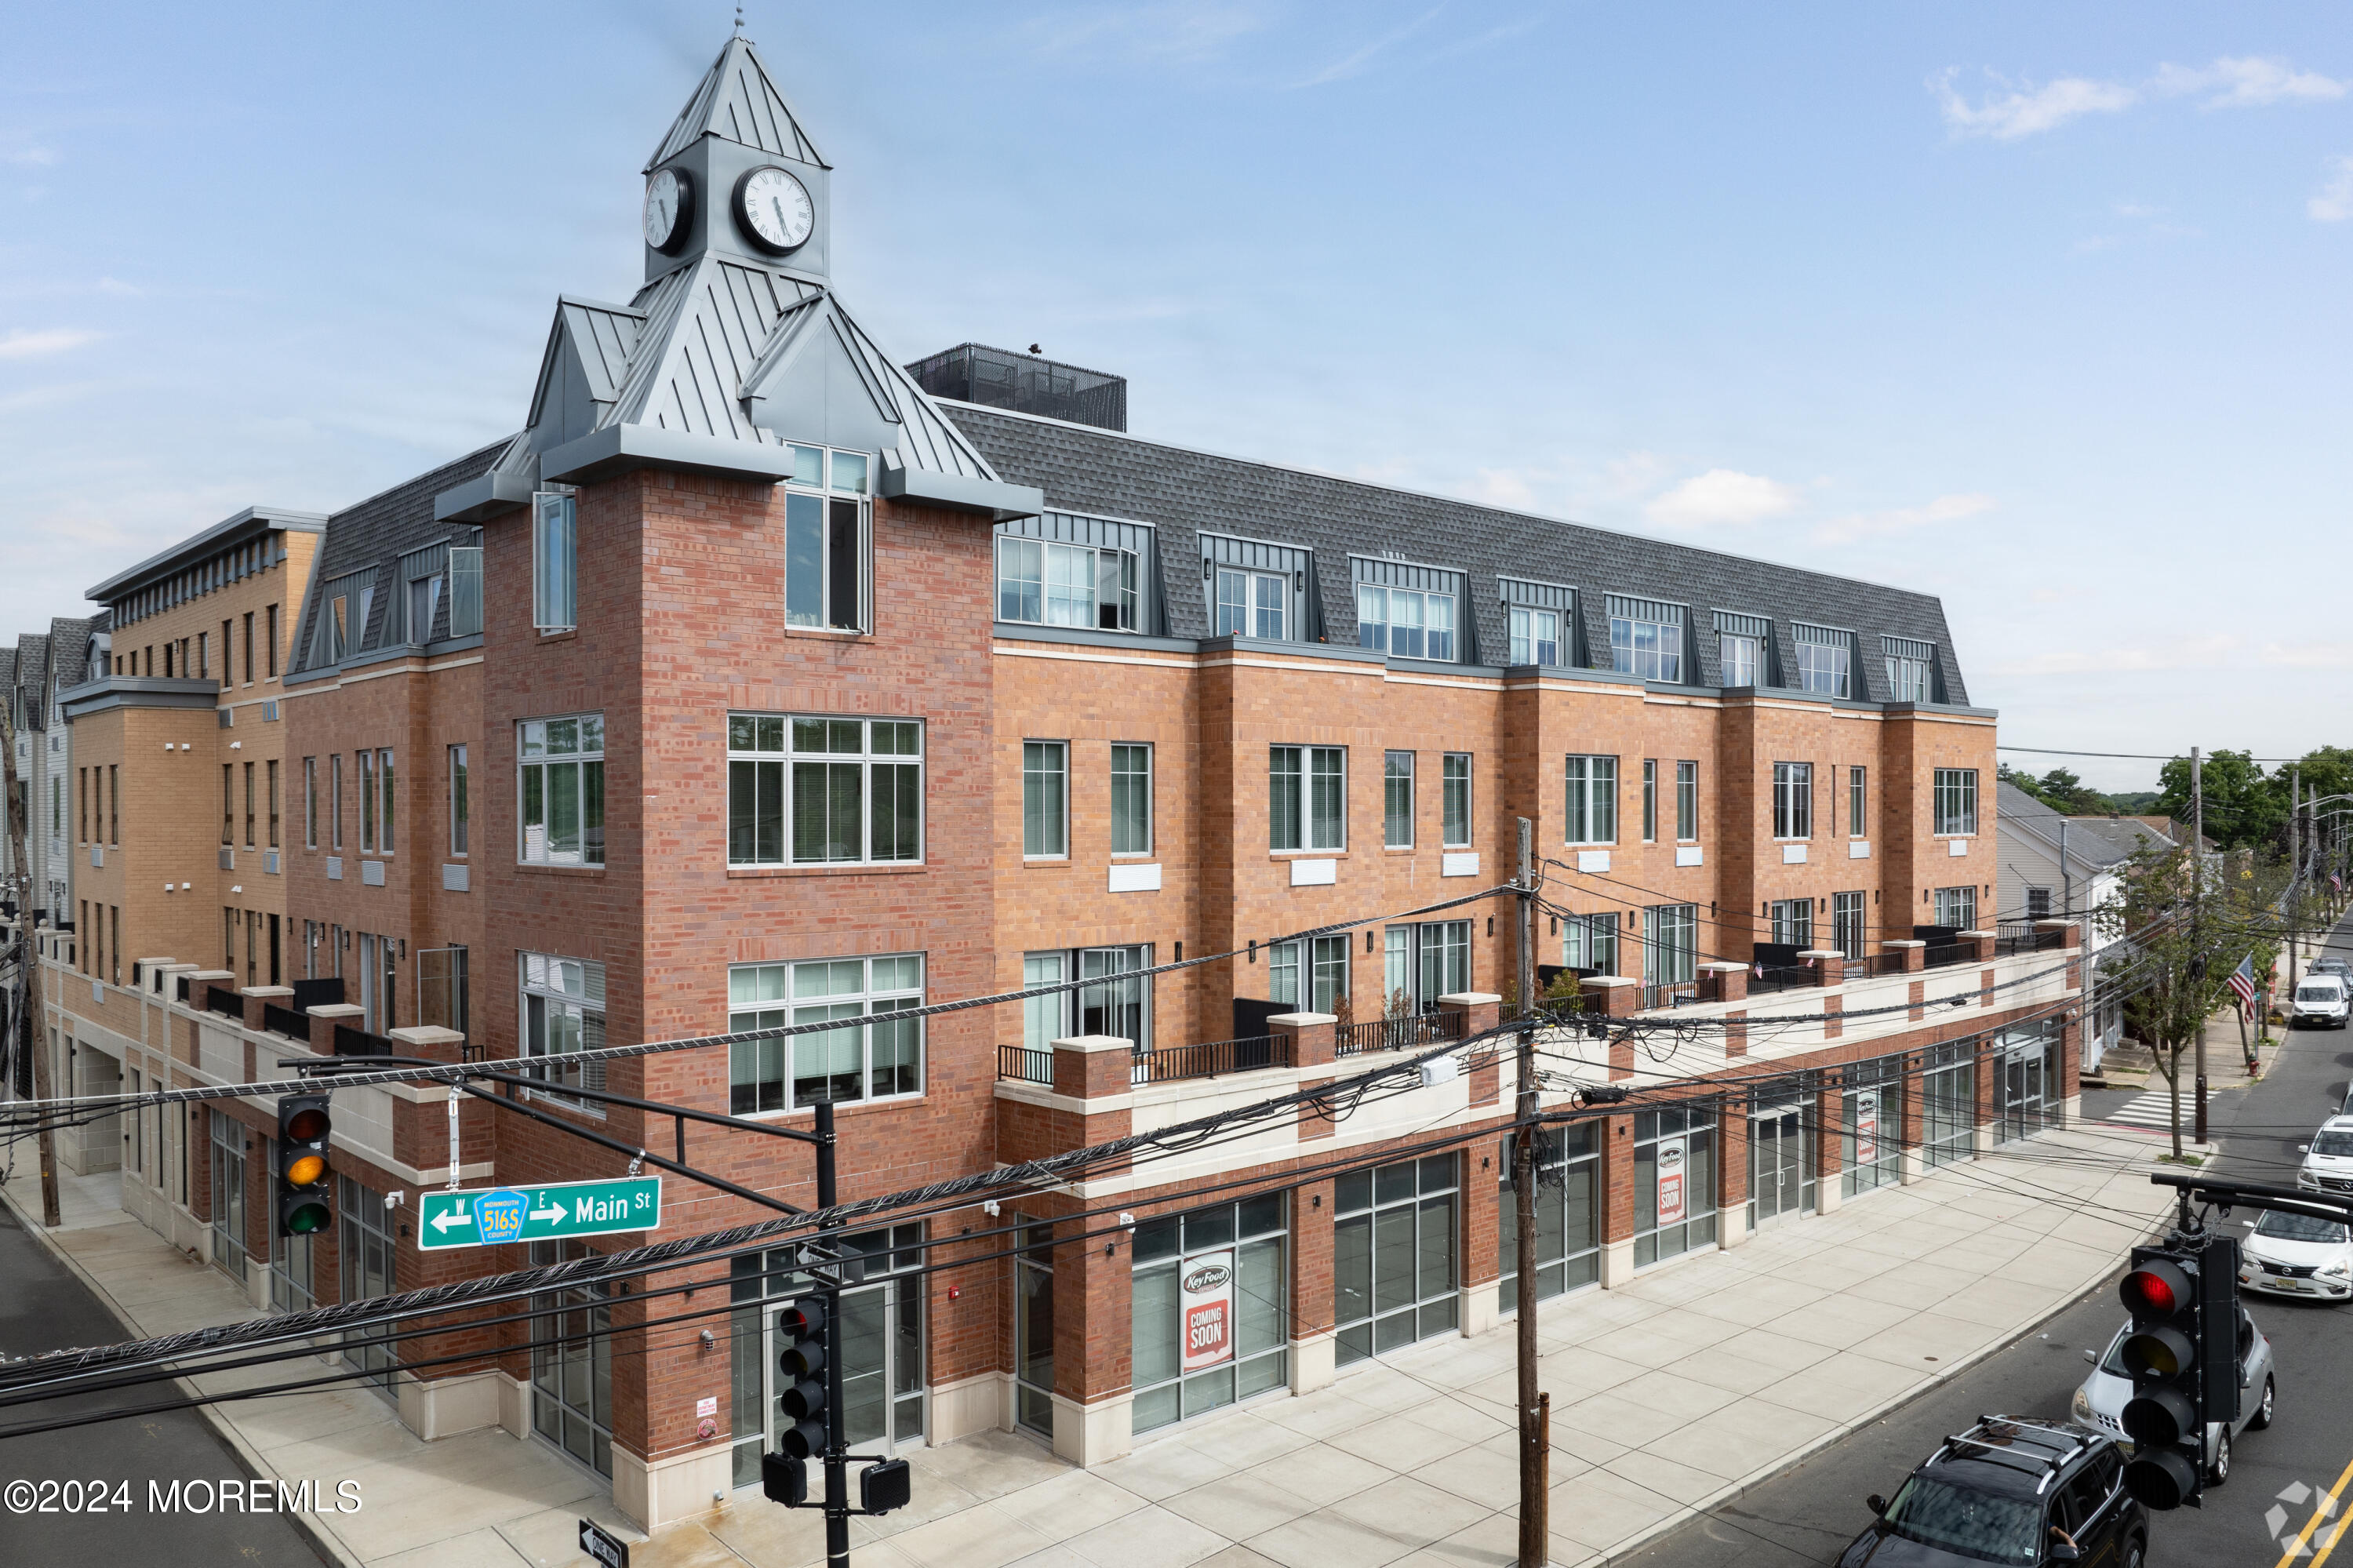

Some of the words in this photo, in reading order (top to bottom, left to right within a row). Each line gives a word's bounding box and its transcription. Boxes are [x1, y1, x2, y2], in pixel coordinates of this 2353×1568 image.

[1661, 1179, 1679, 1194] COMING
[455, 1199, 466, 1216] W
[484, 1199, 519, 1208] MONMOUTH
[539, 1191, 546, 1209] E
[576, 1195, 628, 1224] Main
[635, 1192, 651, 1210] St
[1661, 1190, 1679, 1210] SOON
[484, 1208, 519, 1231] 516S
[1187, 1275, 1205, 1290] Key
[1204, 1269, 1226, 1285] Food
[1191, 1306, 1222, 1328] COMING
[1191, 1322, 1222, 1349] SOON
[592, 1537, 605, 1555] ONE
[606, 1546, 617, 1565] WAY
